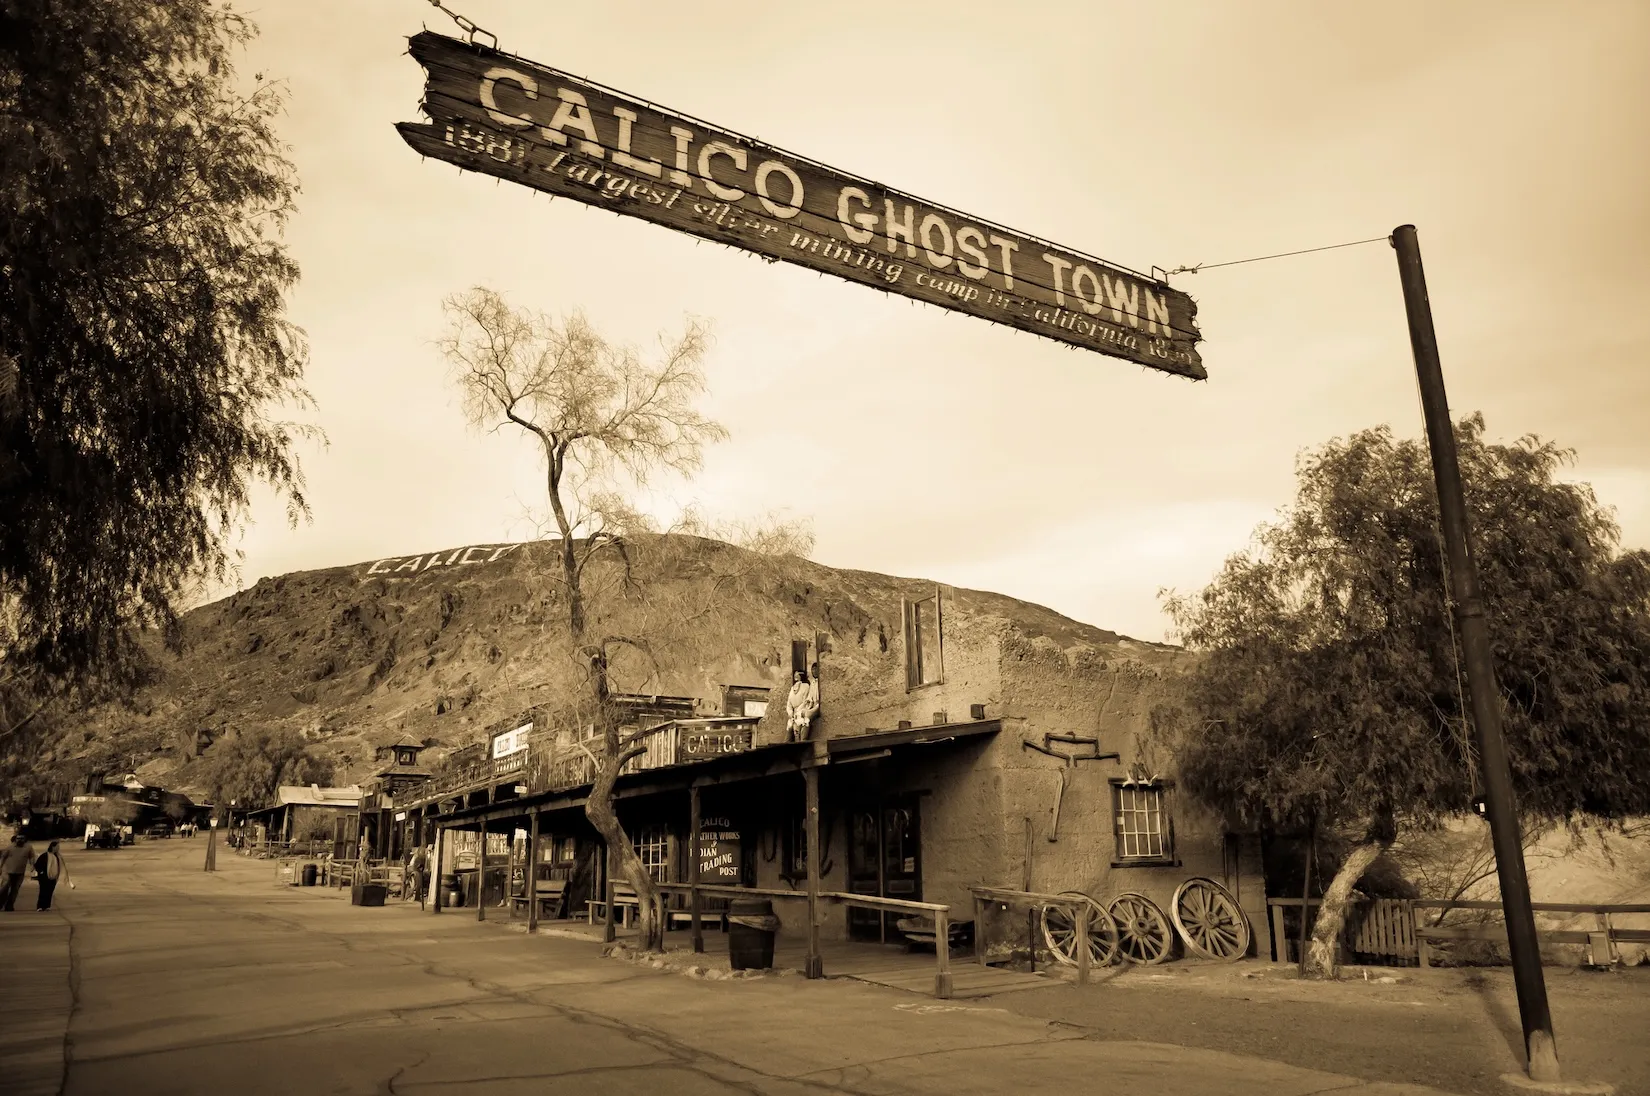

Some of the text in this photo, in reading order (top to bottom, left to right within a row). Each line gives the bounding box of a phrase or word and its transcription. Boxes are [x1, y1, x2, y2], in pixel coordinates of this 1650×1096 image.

[478, 67, 1172, 339] CALICO GHOST TOWN
[789, 232, 904, 284] mining
[986, 288, 1011, 310] in
[687, 734, 743, 754] CALICO
[699, 852, 733, 873] TRADING
[719, 866, 738, 876] POST
